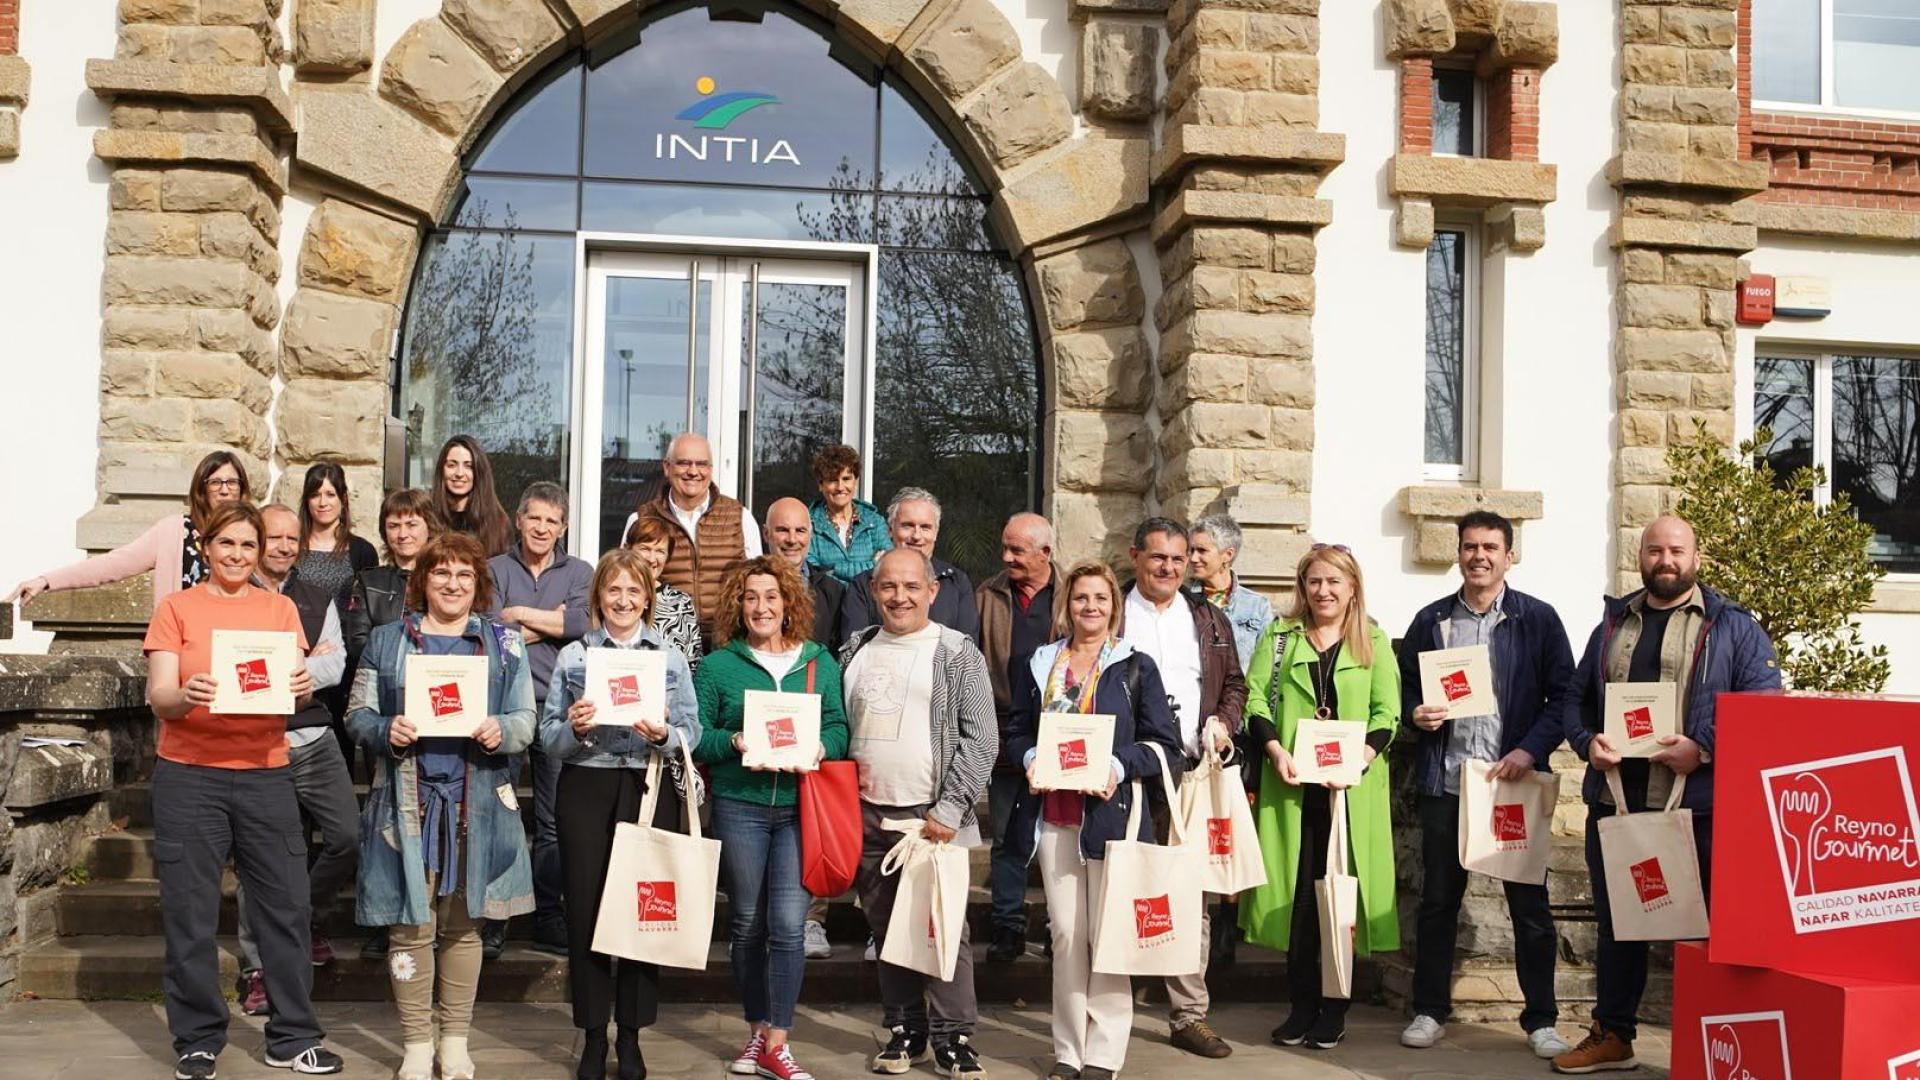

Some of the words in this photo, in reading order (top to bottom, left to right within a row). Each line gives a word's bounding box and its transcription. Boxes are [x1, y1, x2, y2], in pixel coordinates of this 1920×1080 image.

[656, 133, 800, 165] INTIA
[1745, 288, 1771, 296] FUEGO
[1835, 815, 1896, 839] Reyno
[1814, 826, 1918, 868] Gourmet
[1796, 896, 1855, 912] CALIDAD
[1801, 911, 1850, 926] NAFAR
